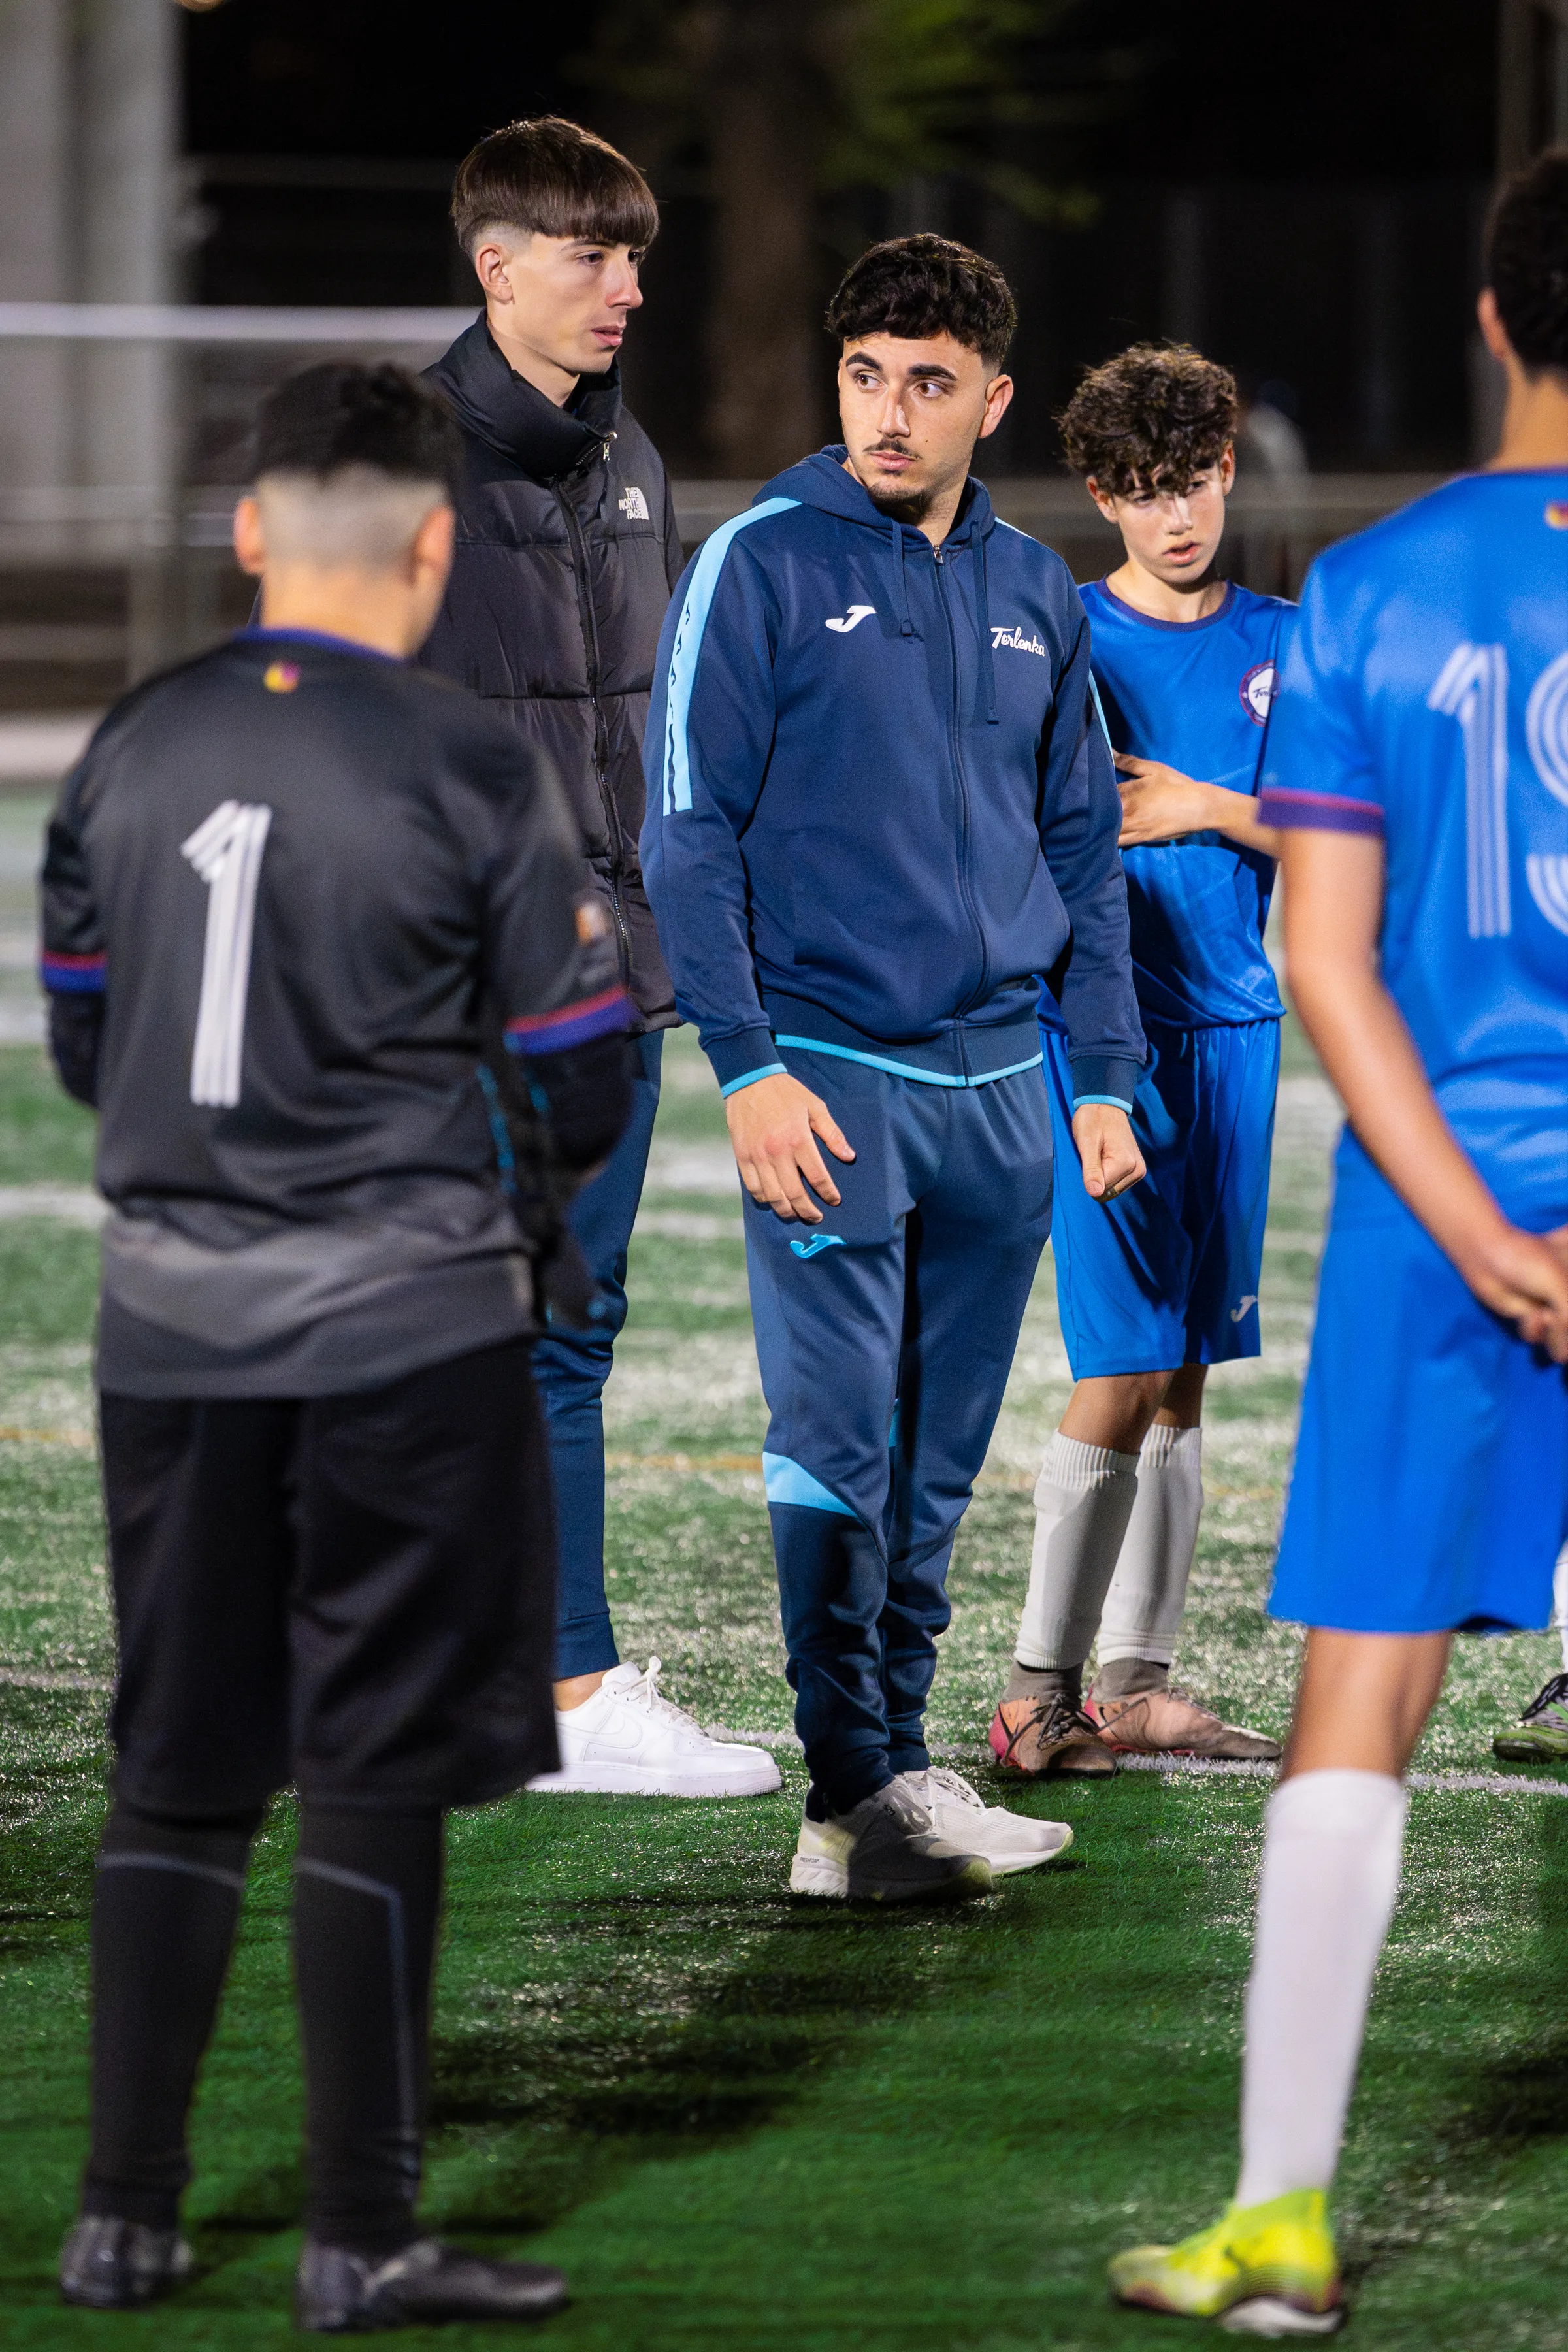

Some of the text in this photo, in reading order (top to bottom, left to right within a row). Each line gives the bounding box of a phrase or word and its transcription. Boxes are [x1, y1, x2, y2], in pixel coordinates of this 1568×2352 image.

[619, 498, 640, 510] NORTH
[990, 626, 1045, 657] Terlenka
[180, 799, 272, 1109] 1
